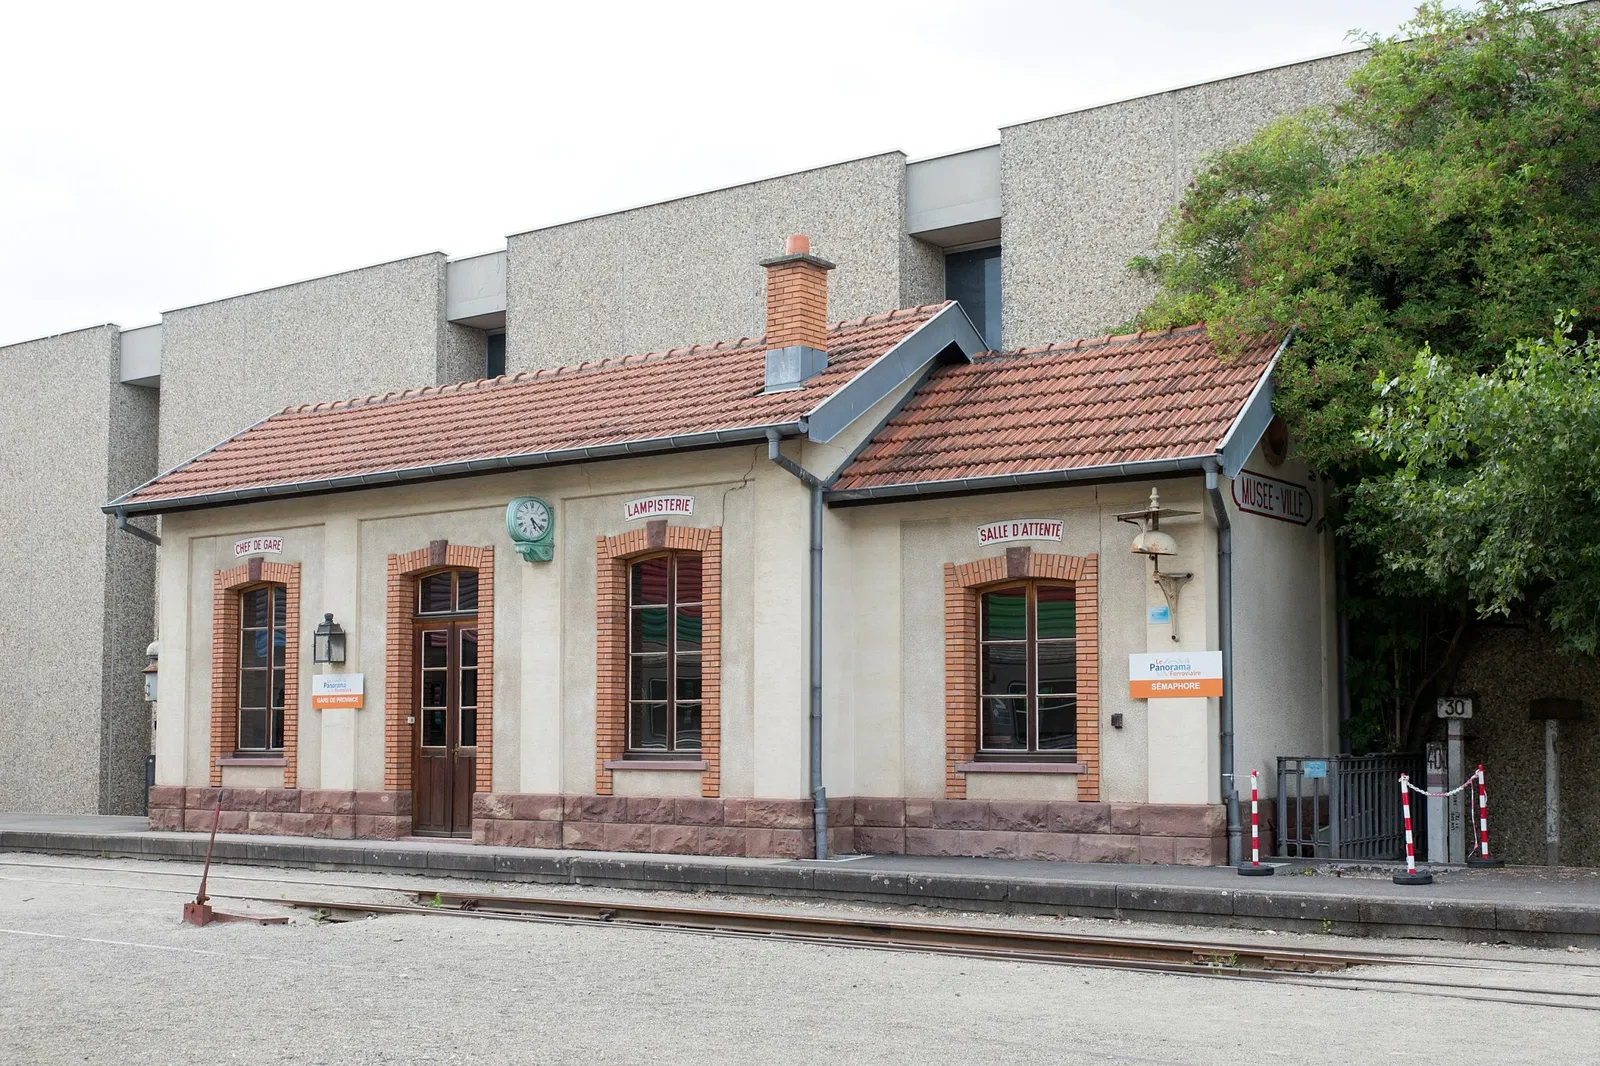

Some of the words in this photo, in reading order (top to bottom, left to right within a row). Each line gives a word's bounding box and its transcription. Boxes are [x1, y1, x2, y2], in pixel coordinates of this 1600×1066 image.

[627, 498, 691, 517] LAMPISTERIE
[980, 524, 1009, 542] SALLE
[1012, 522, 1062, 537] D'ATTENTE
[235, 541, 251, 555] CHEF
[253, 539, 262, 550] DE
[263, 539, 281, 550] GARE
[1149, 663, 1191, 672] Panorama
[1151, 681, 1201, 691] SÉMAPHORE
[1445, 700, 1465, 716] 30
